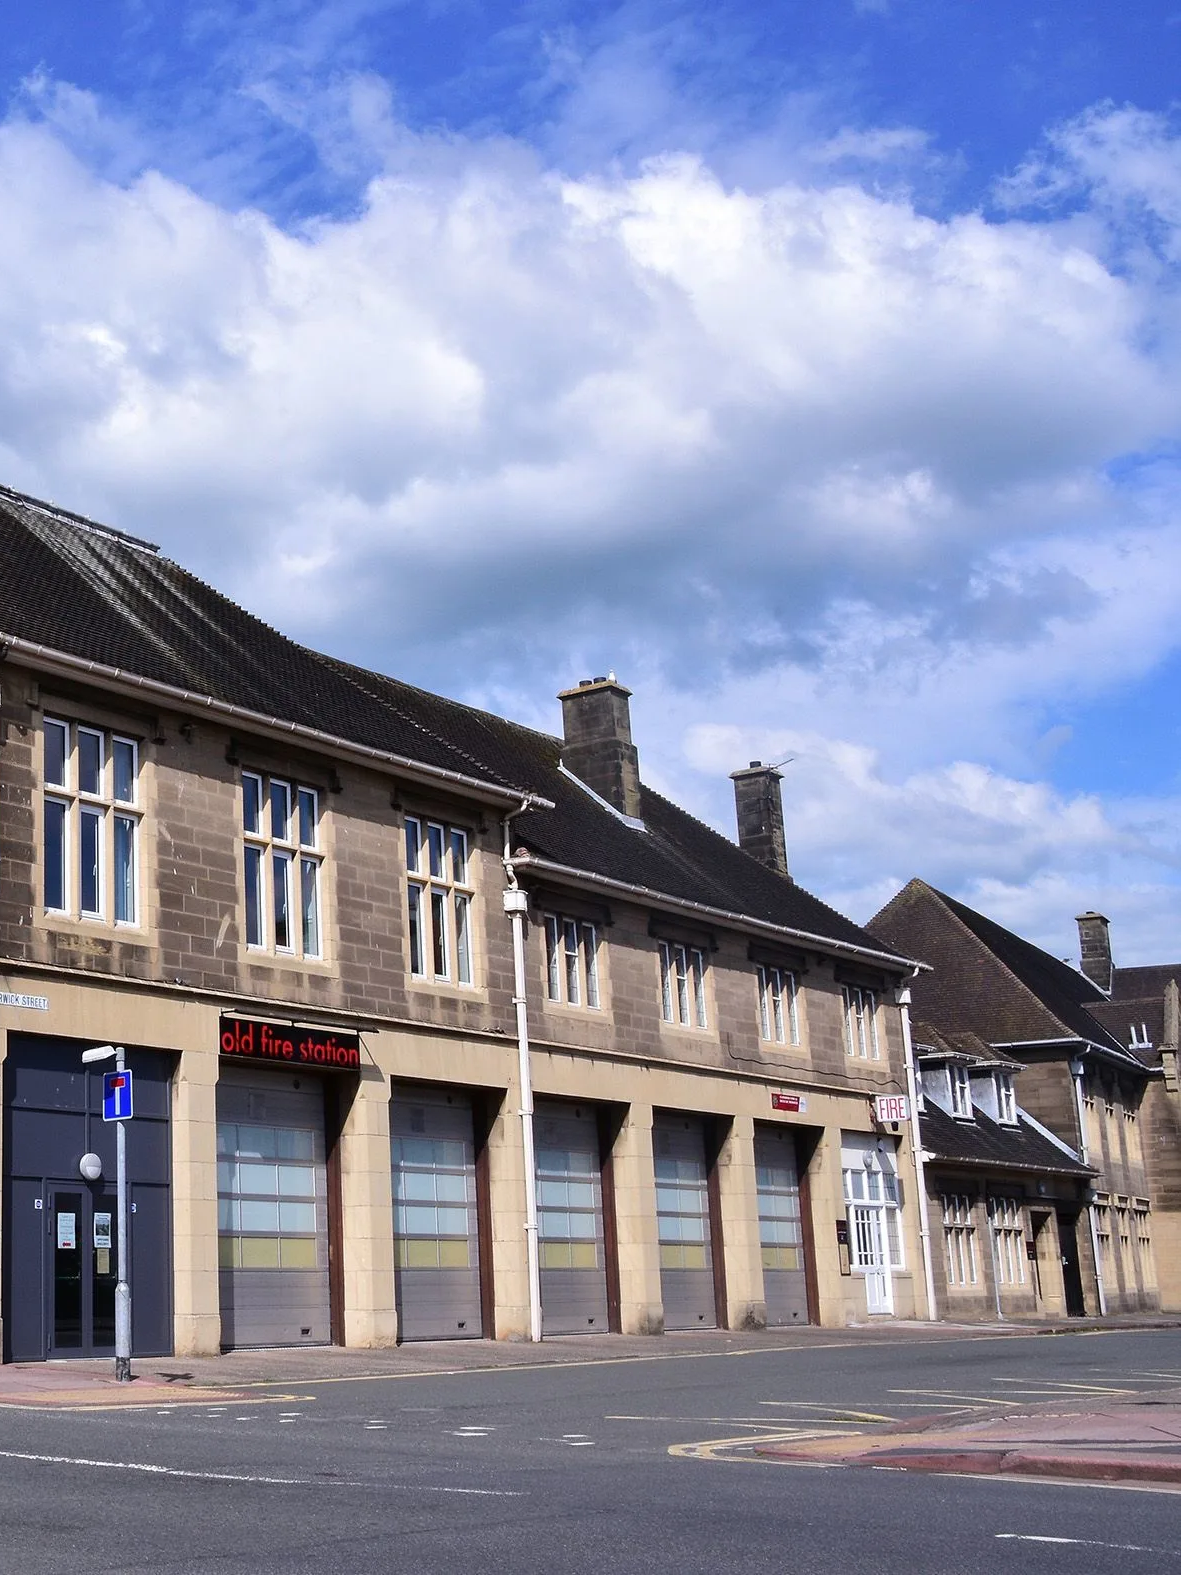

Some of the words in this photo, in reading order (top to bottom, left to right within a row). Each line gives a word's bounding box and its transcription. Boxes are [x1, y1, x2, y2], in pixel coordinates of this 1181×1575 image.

[21, 995, 46, 1008] STREET
[221, 1021, 253, 1053] old
[261, 1024, 294, 1059] fire
[299, 1037, 359, 1067] station
[879, 1097, 906, 1119] FIRE
